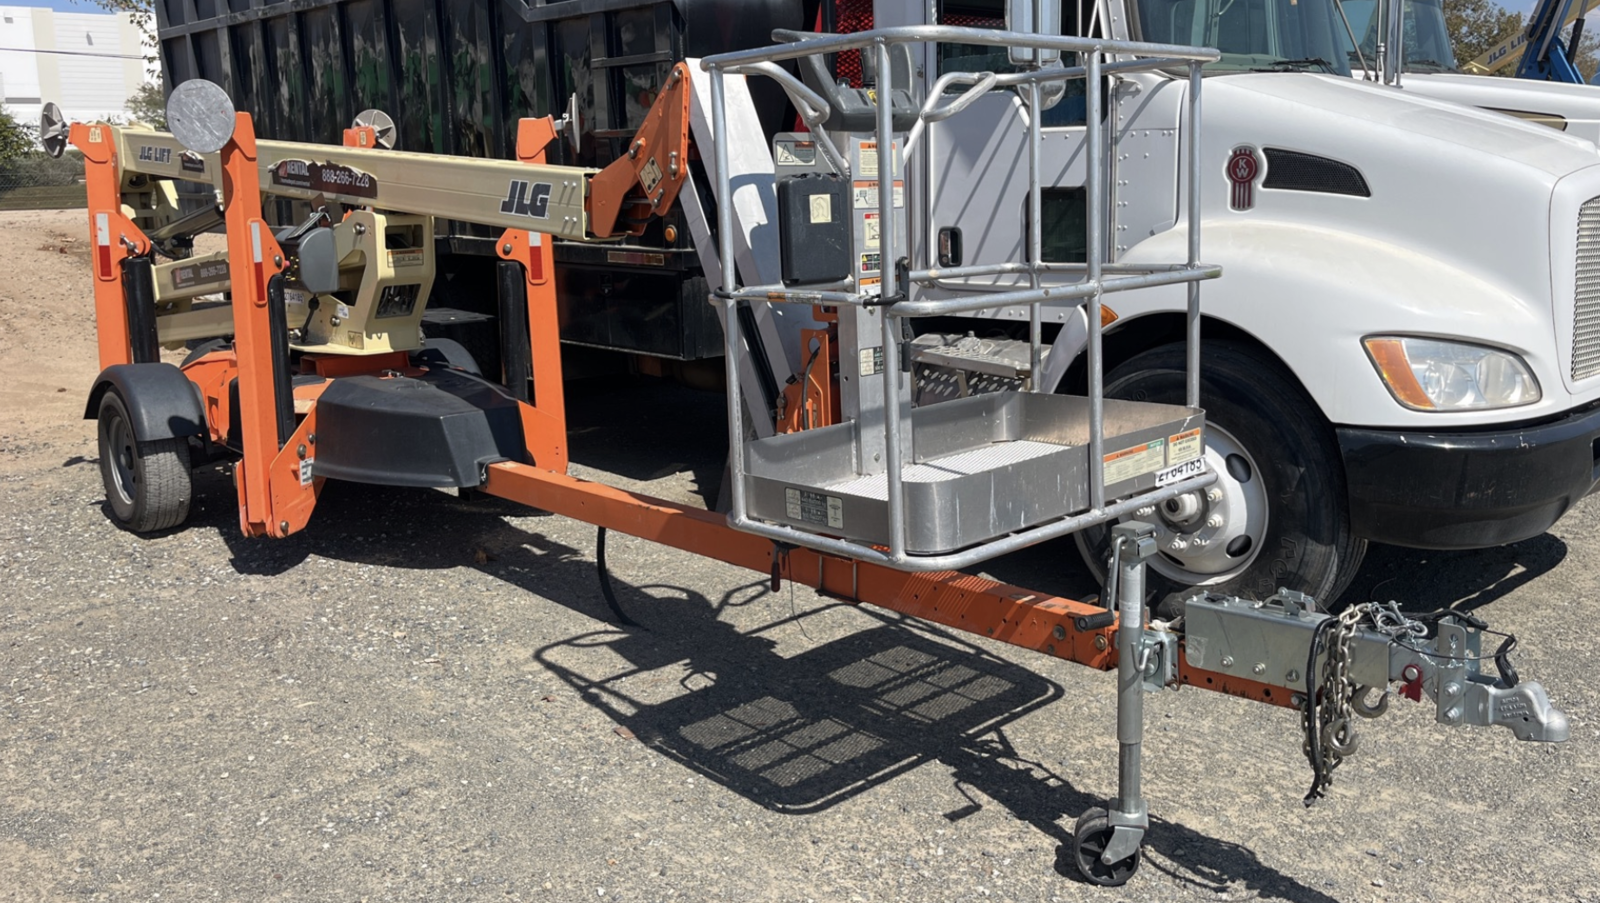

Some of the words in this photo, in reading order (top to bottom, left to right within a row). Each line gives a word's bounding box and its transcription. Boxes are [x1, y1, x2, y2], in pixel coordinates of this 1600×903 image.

[1487, 45, 1507, 65] JLG
[139, 146, 153, 161] JLG
[154, 147, 171, 164] LIFT
[1238, 158, 1247, 168] K
[287, 161, 309, 176] RENTAL
[1236, 167, 1249, 178] W
[321, 168, 370, 188] 888-266-7228
[500, 179, 553, 219] JLG
